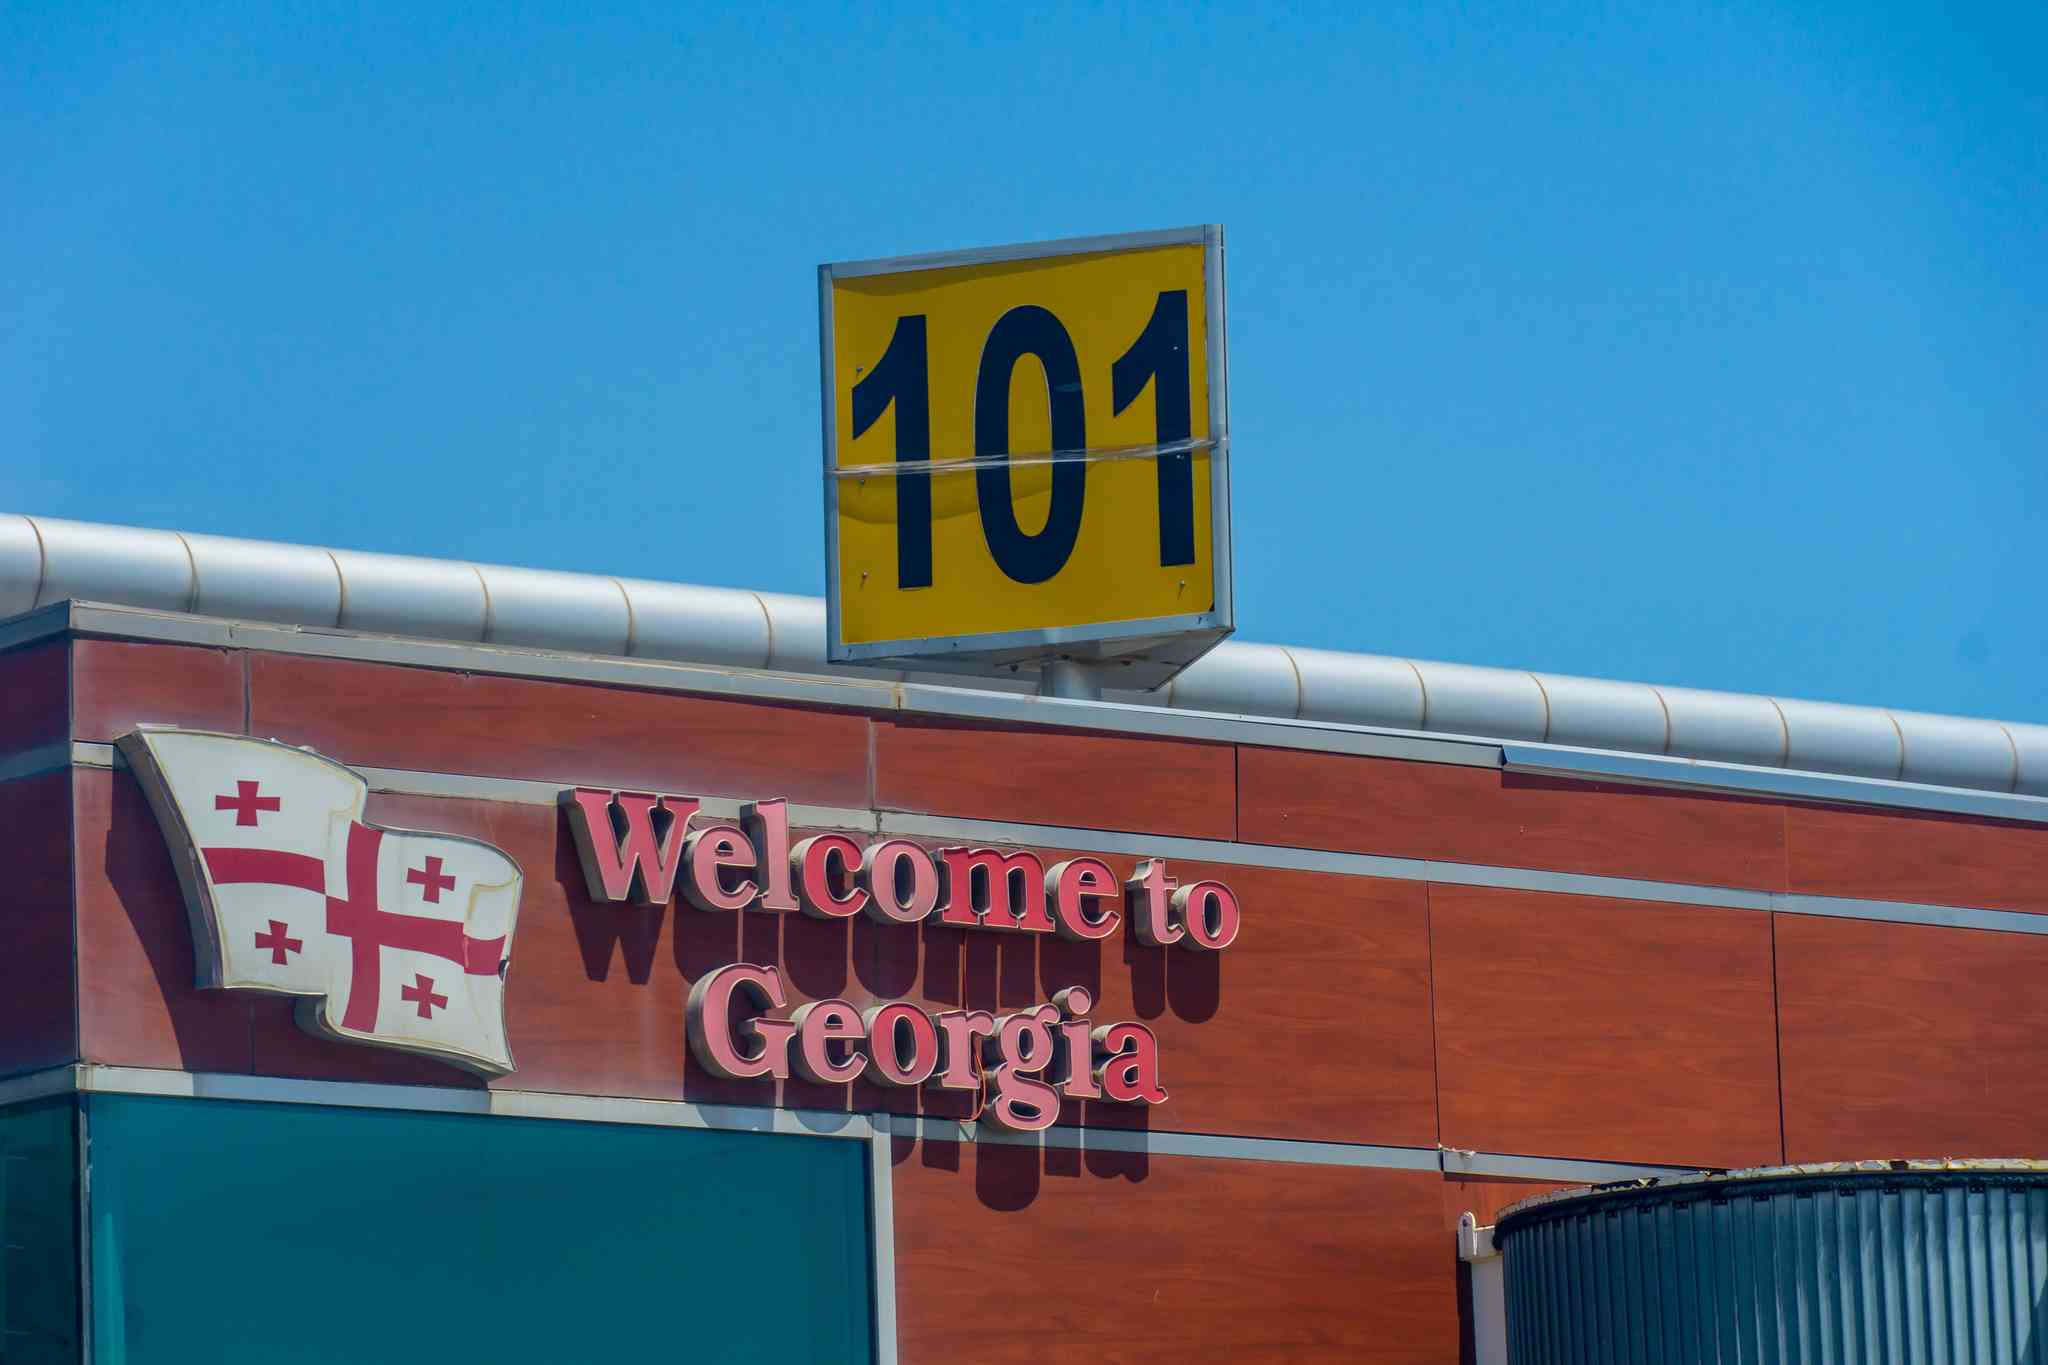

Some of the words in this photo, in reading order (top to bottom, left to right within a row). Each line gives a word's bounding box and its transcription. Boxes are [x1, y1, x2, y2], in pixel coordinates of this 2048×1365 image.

[851, 289, 1196, 590] 101
[562, 786, 1122, 940] Welcome
[1127, 857, 1241, 951] to
[688, 961, 1169, 1131] Georgia
